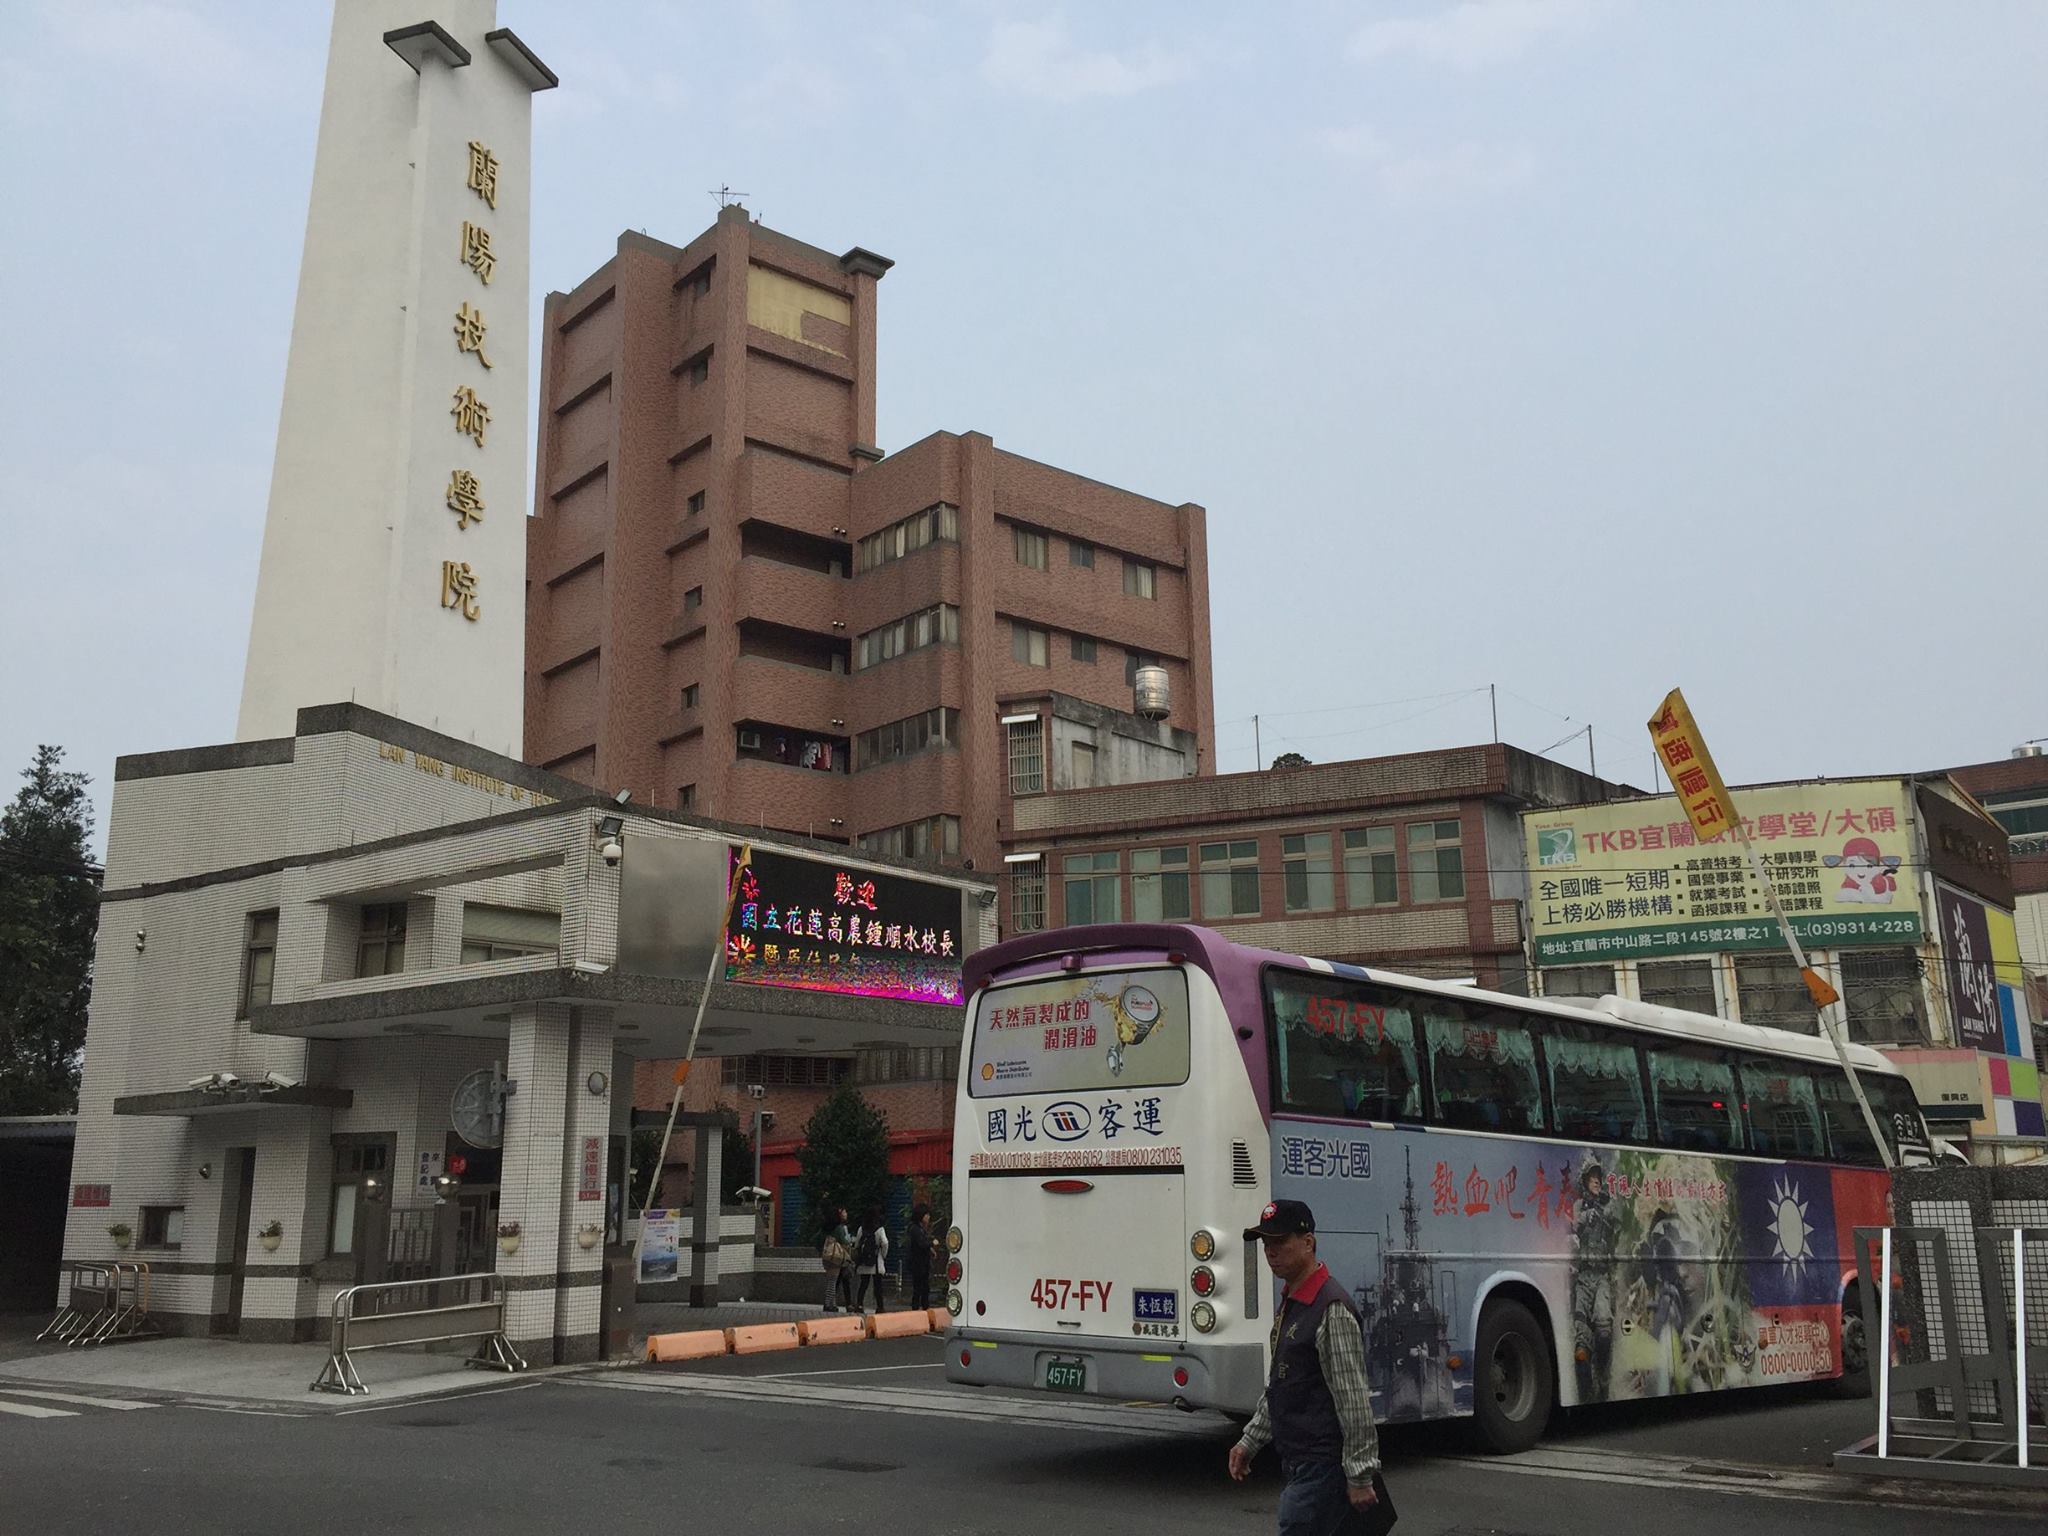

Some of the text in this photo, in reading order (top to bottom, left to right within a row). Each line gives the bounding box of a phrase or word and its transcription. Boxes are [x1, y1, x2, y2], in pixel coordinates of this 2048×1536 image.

[441, 140, 500, 622] 蘭陽技術學院
[379, 741, 406, 763] LAN
[415, 752, 444, 778] YANG
[453, 765, 506, 796] INSTITUTE
[511, 784, 525, 801] OF
[1583, 806, 1896, 854] TKB宜蘭位學堂/大碩
[1540, 853, 1576, 866] TKB
[1686, 856, 1742, 872] 高普特考
[1759, 850, 1817, 867] 大學轉學
[834, 872, 878, 911] 歡迎
[1539, 870, 1670, 901] 全國唯一短期
[1688, 871, 1745, 886] 國營事業
[1689, 887, 1747, 901] 就業考試
[1542, 895, 1673, 926] 上榜必勝機構
[1691, 901, 1748, 917] 函授課程
[990, 1000, 1090, 1030] 天然氣製成的
[1044, 1025, 1098, 1050] 潤滑油
[1031, 1278, 1113, 1313] 457-FY
[1048, 1369, 1083, 1386] 457-FY
